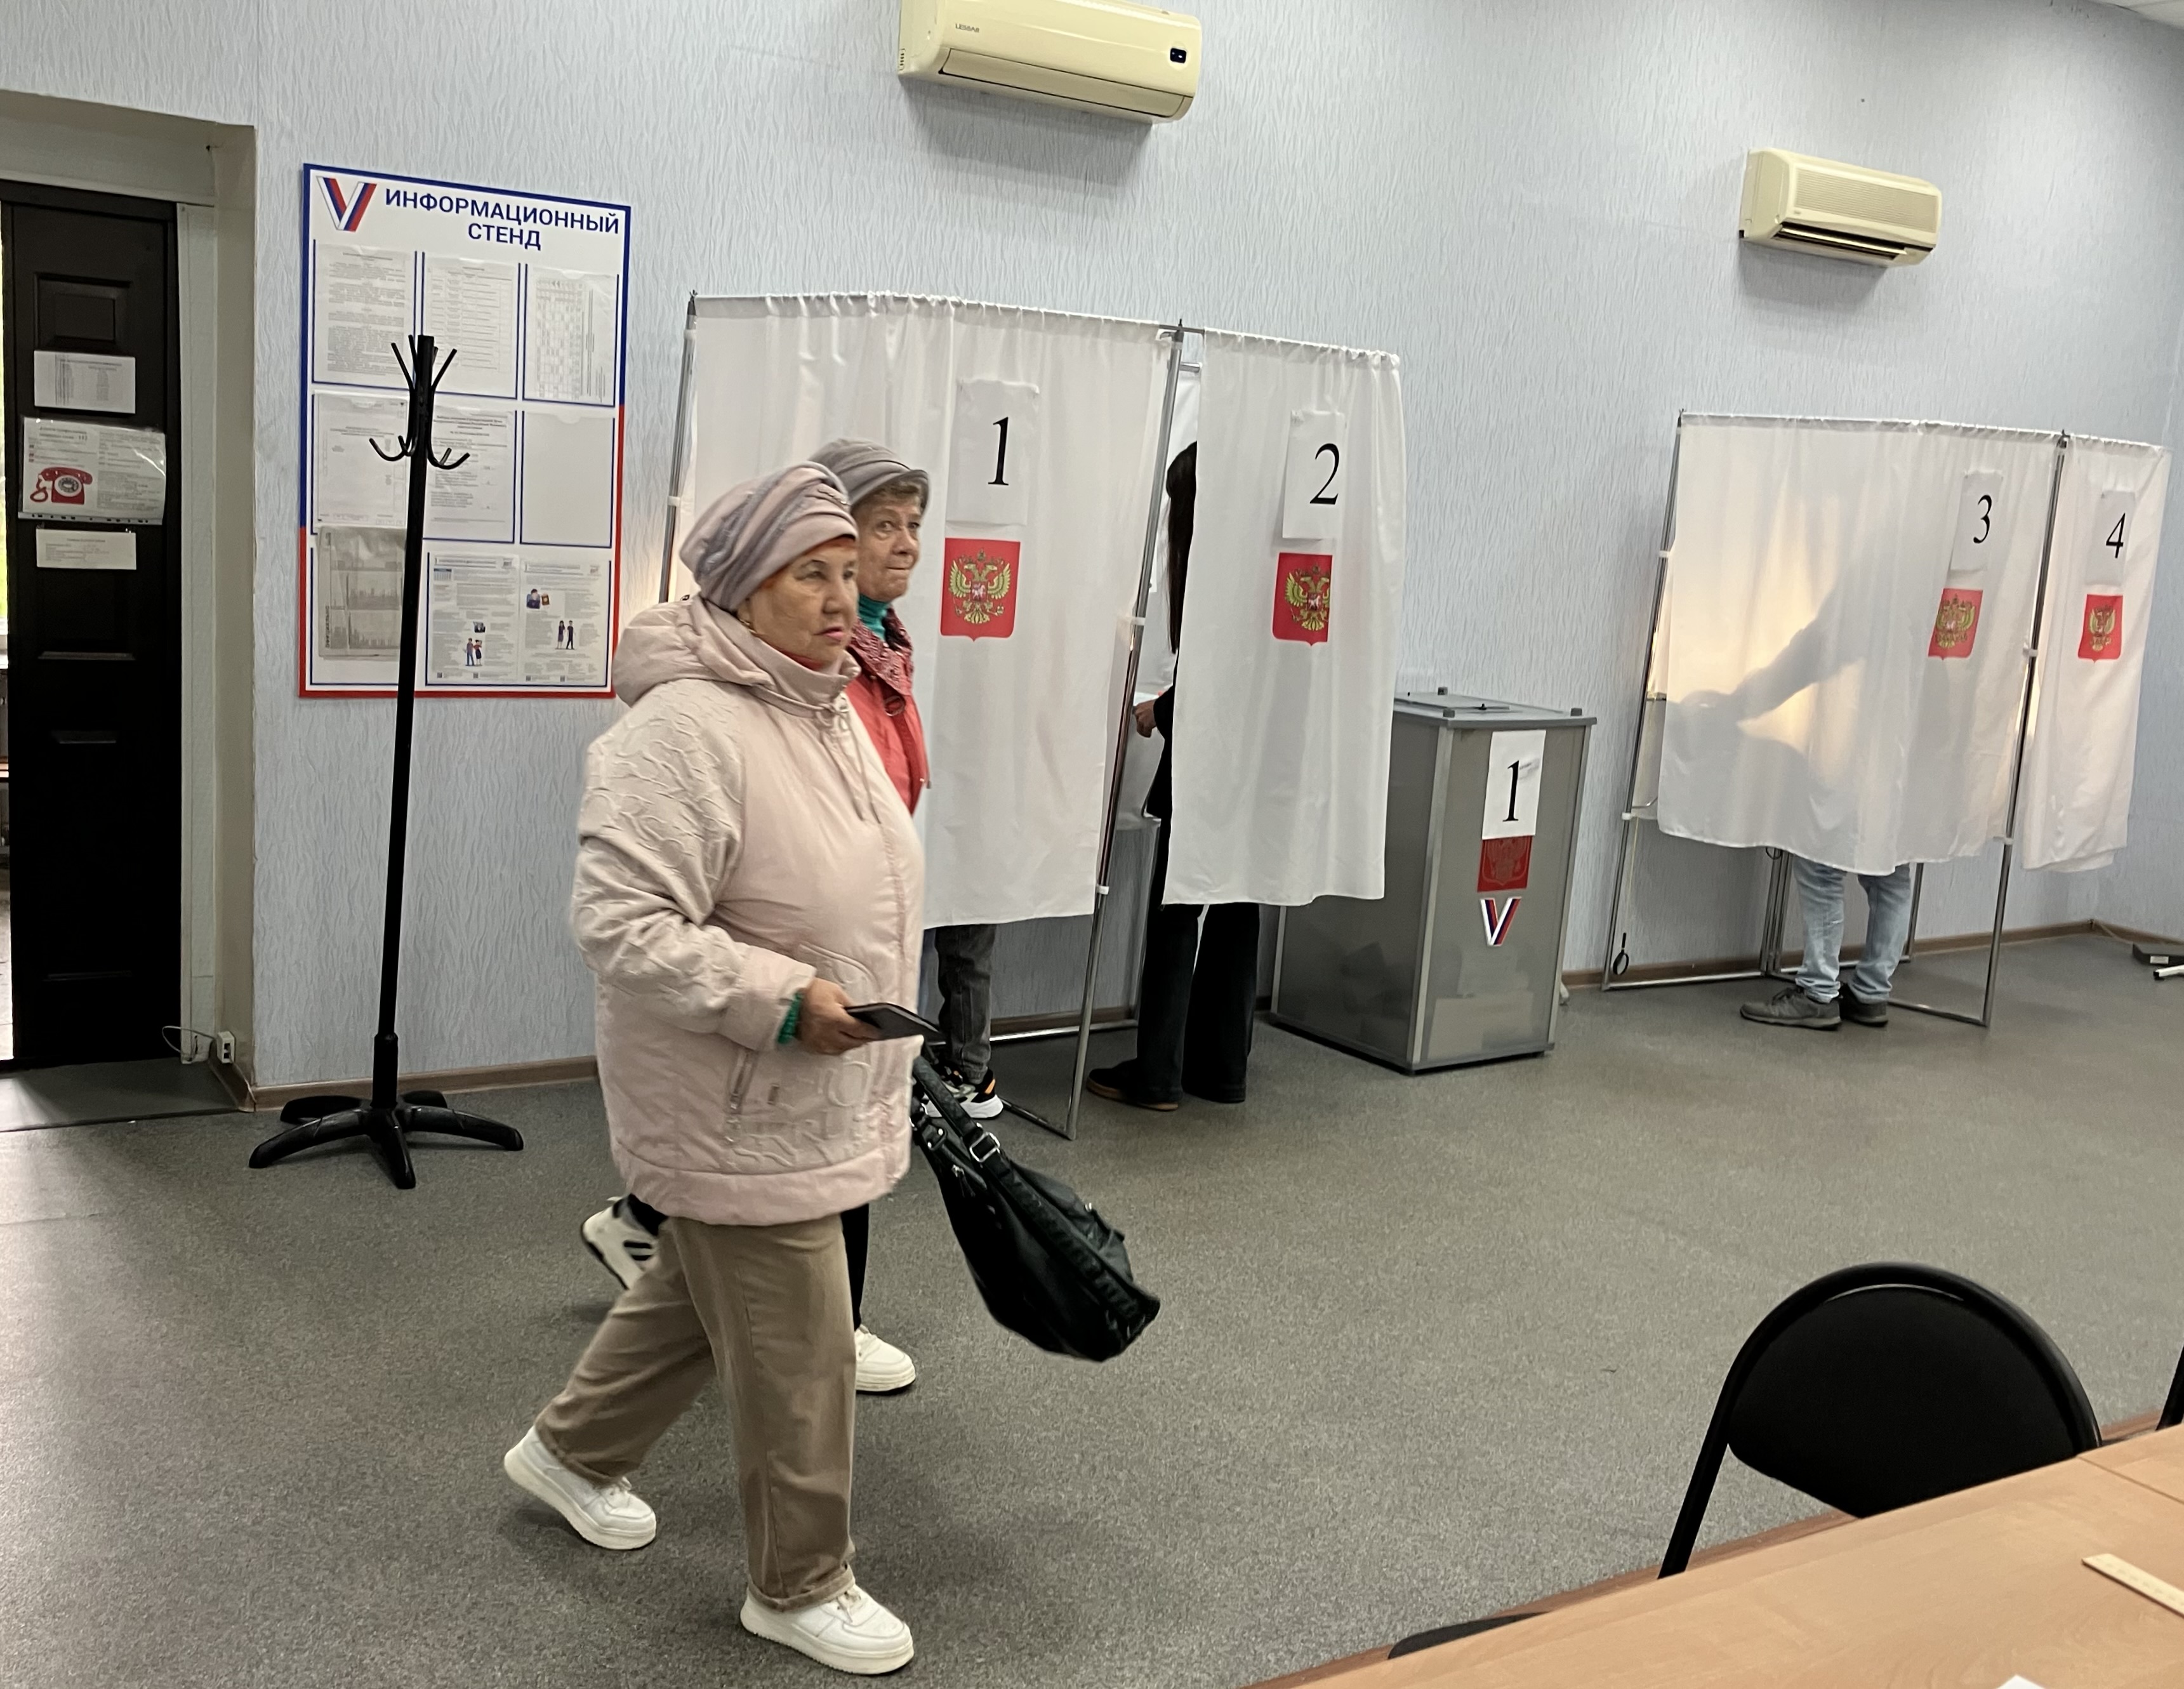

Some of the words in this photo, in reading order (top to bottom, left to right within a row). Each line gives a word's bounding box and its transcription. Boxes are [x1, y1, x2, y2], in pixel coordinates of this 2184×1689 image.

[385, 189, 619, 234] ИНФОРМАЦИОННЫЙ
[468, 222, 541, 251] СТЕНД
[988, 416, 1009, 486] 1
[1309, 443, 1340, 505] 2
[1973, 494, 1992, 544] 3
[2105, 512, 2126, 559] 4
[1502, 760, 1520, 822] 1
